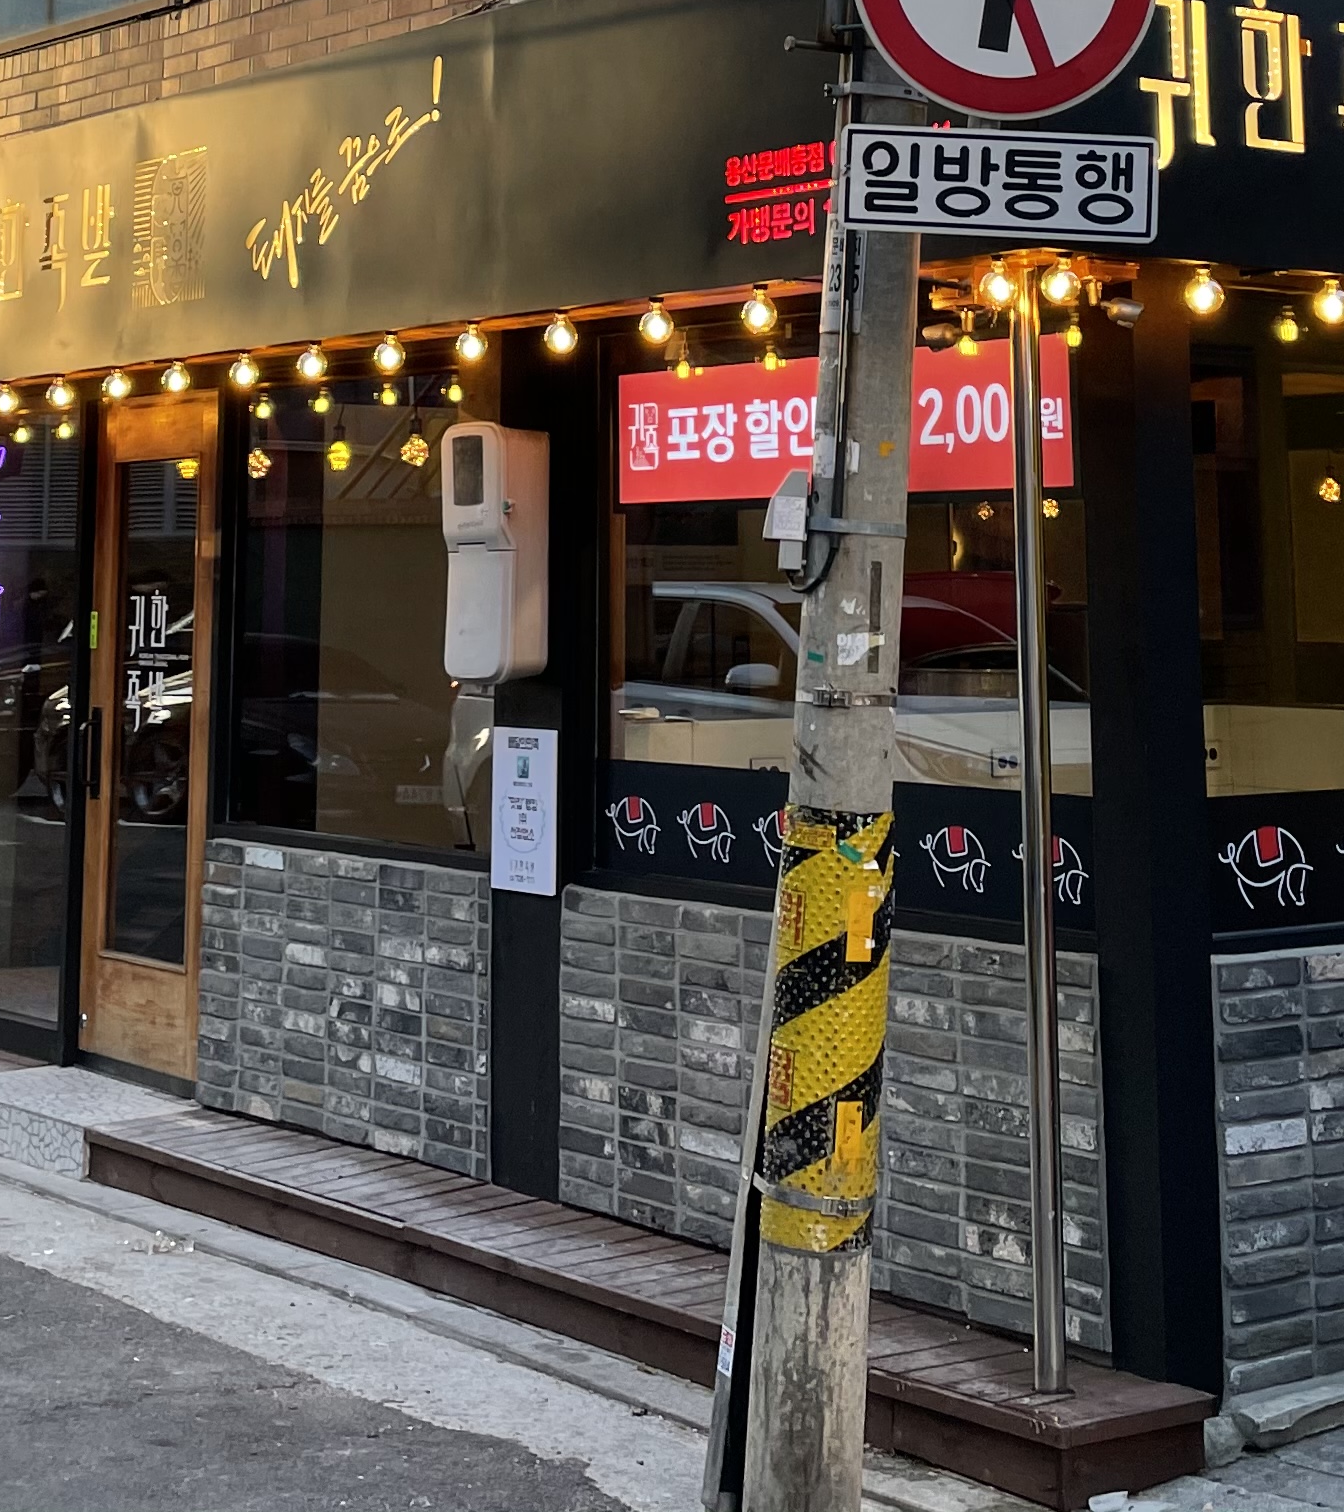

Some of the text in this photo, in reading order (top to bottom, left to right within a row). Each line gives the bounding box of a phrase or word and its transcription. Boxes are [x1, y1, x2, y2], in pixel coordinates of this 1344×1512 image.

[861, 140, 1135, 226] 일방통행
[726, 197, 817, 246] 가맹문의
[666, 404, 737, 463] 포장
